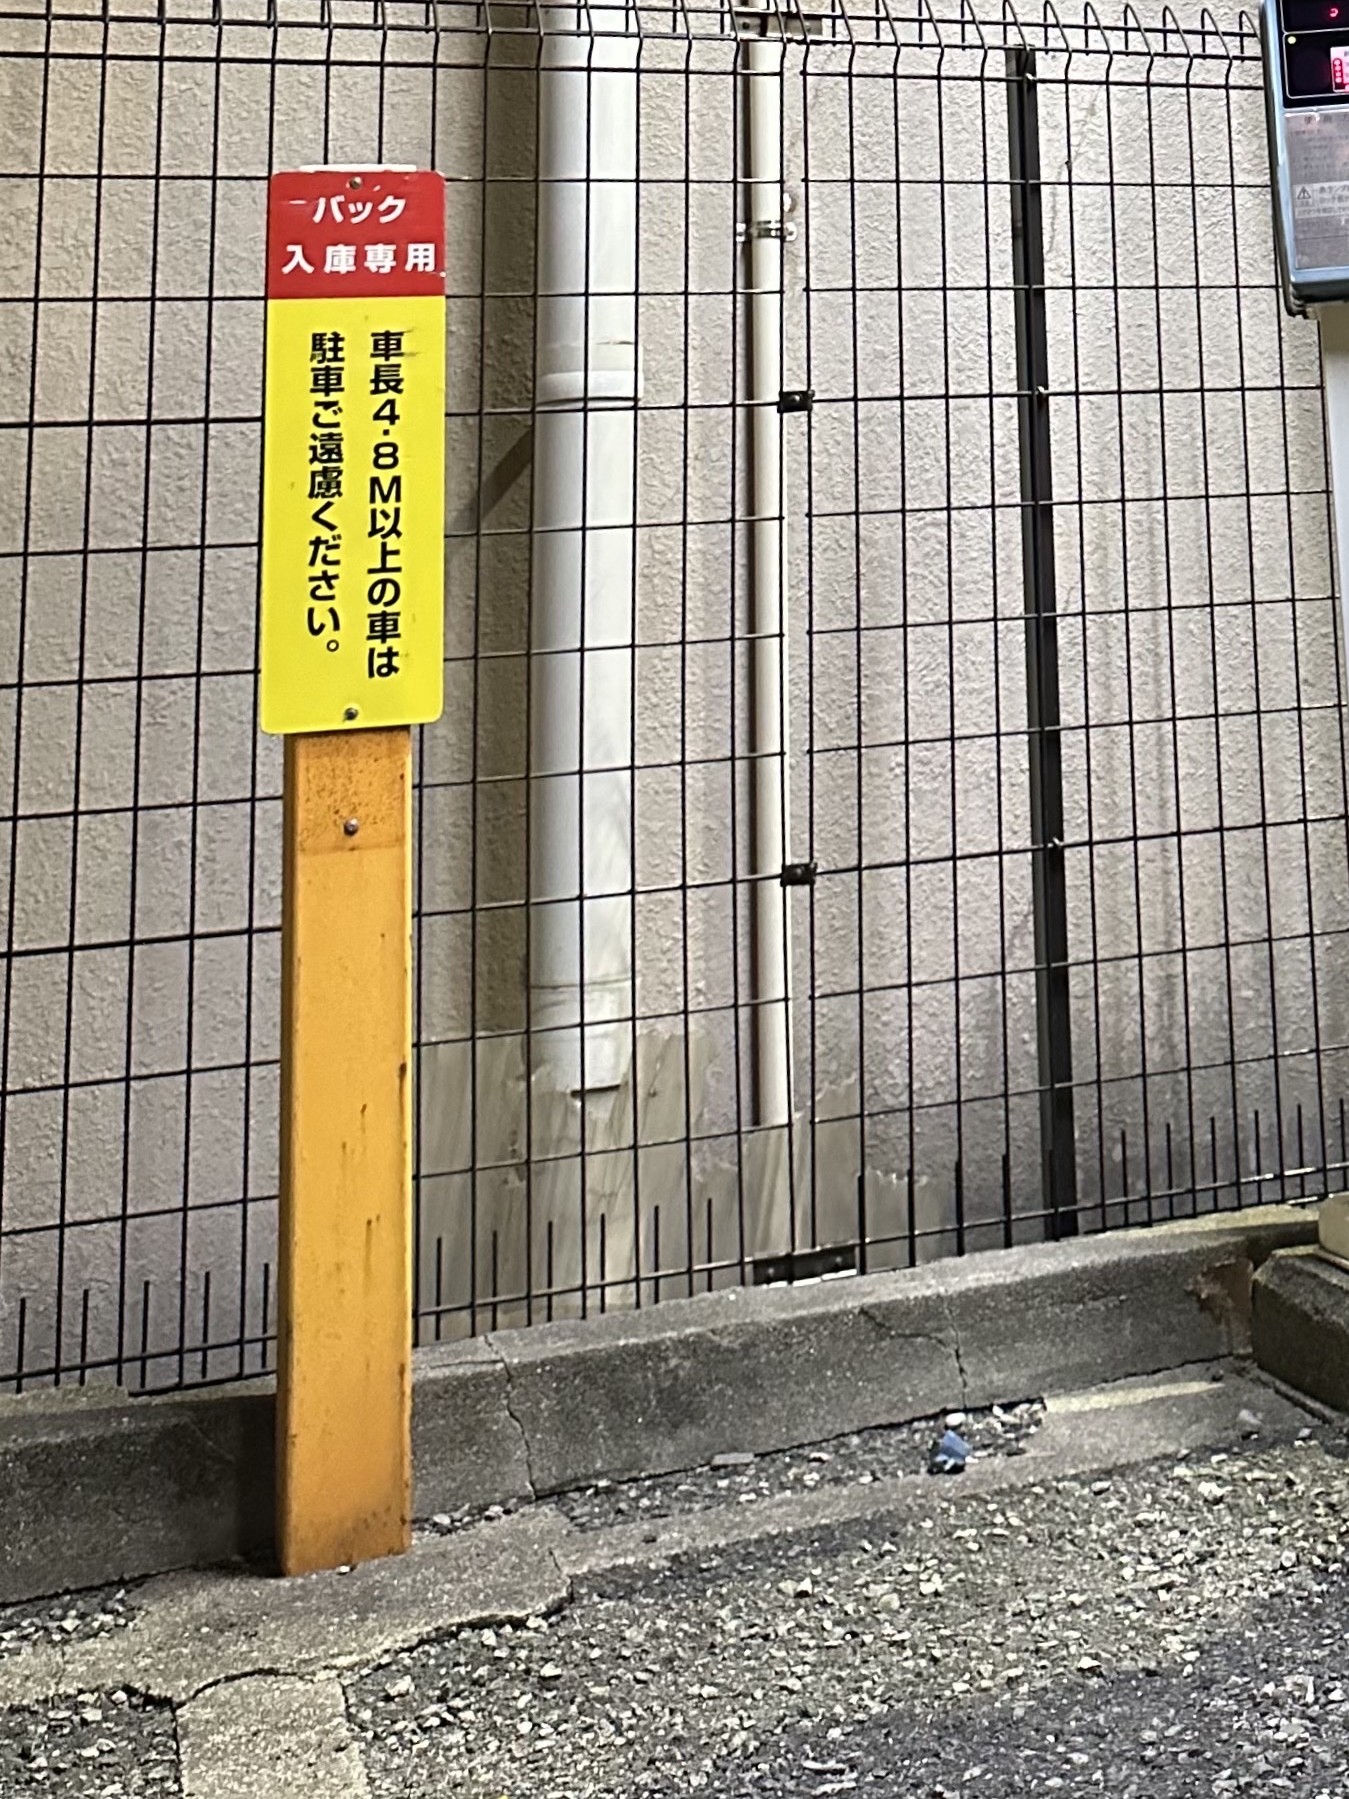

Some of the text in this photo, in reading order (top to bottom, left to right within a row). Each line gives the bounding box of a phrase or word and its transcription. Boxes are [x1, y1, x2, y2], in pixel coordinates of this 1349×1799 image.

[312, 194, 407, 225] バック
[281, 242, 436, 275] 入庫専用
[306, 331, 346, 656] 駐車ご遠慮ください。
